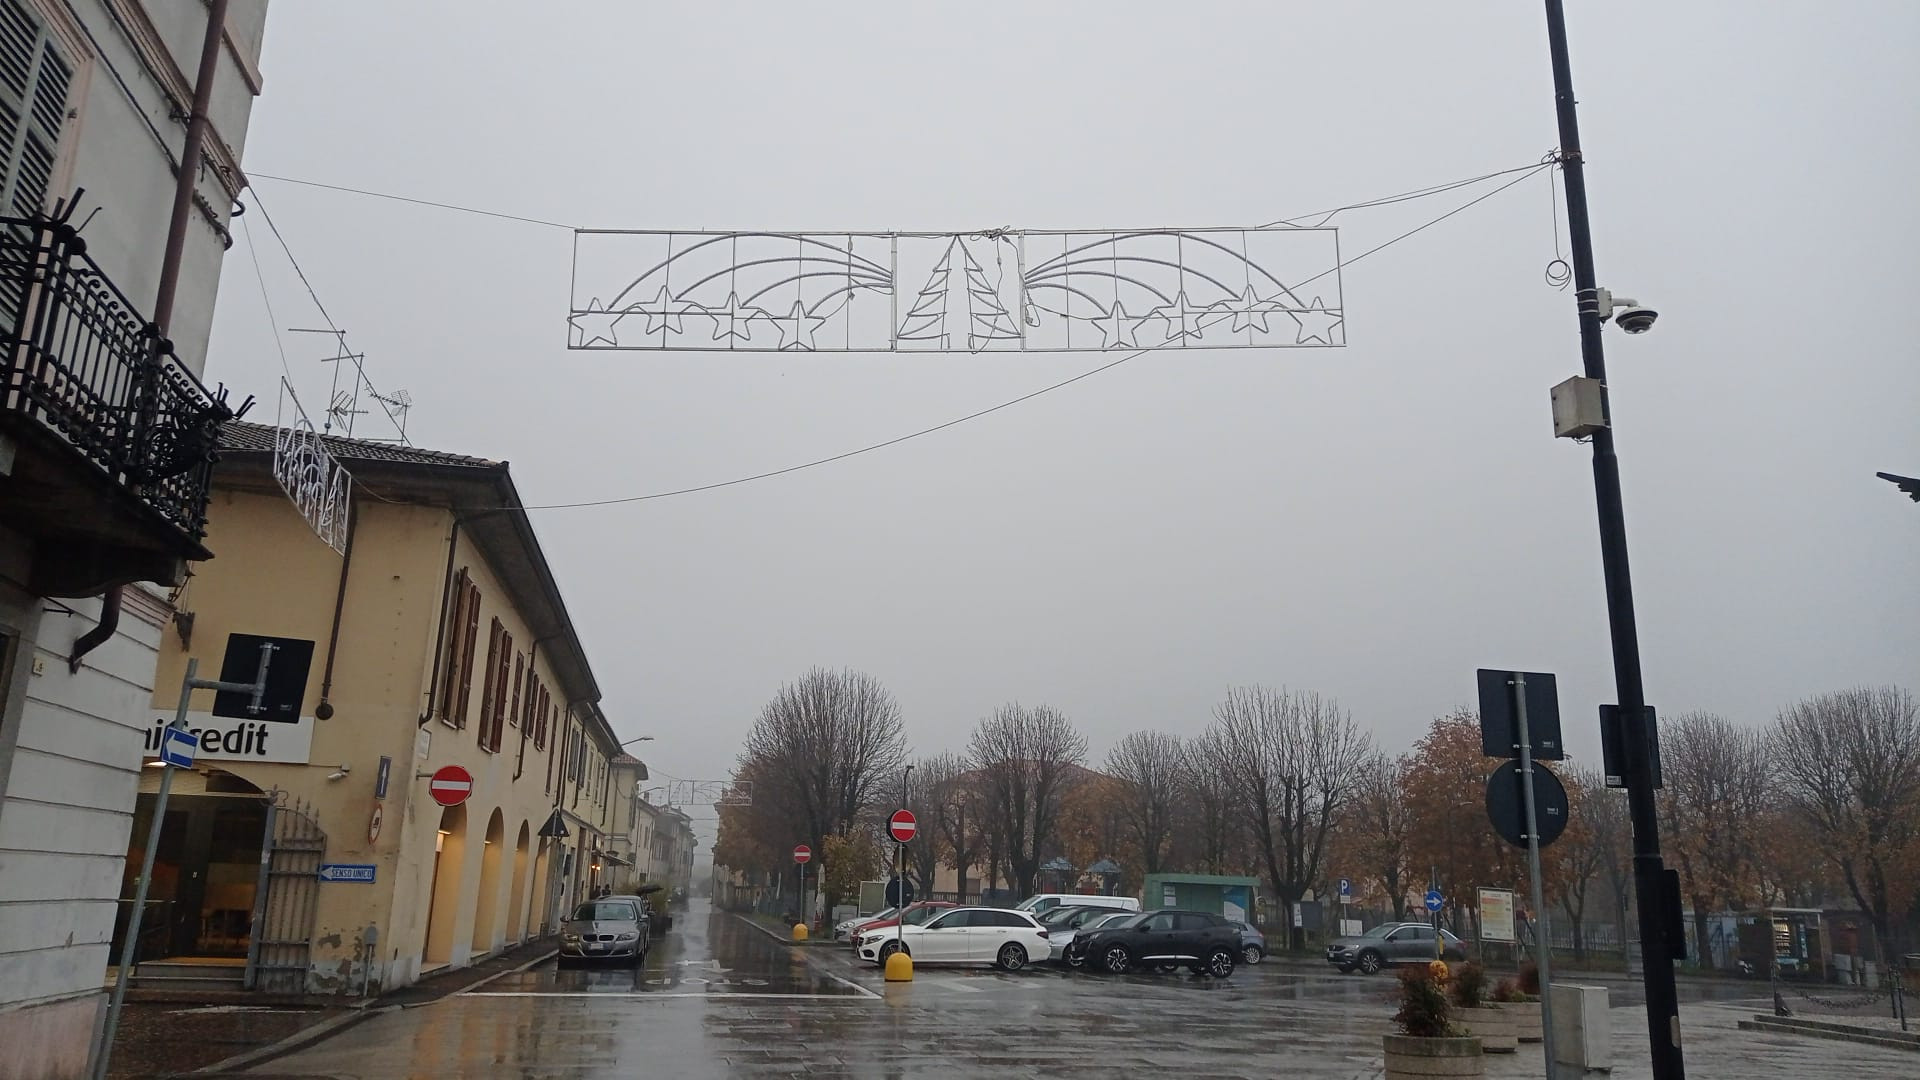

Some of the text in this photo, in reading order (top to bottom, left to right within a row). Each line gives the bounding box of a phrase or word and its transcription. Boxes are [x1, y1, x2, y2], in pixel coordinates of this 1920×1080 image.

[332, 868, 372, 879] SENSO UNICO
[1341, 880, 1348, 894] P
